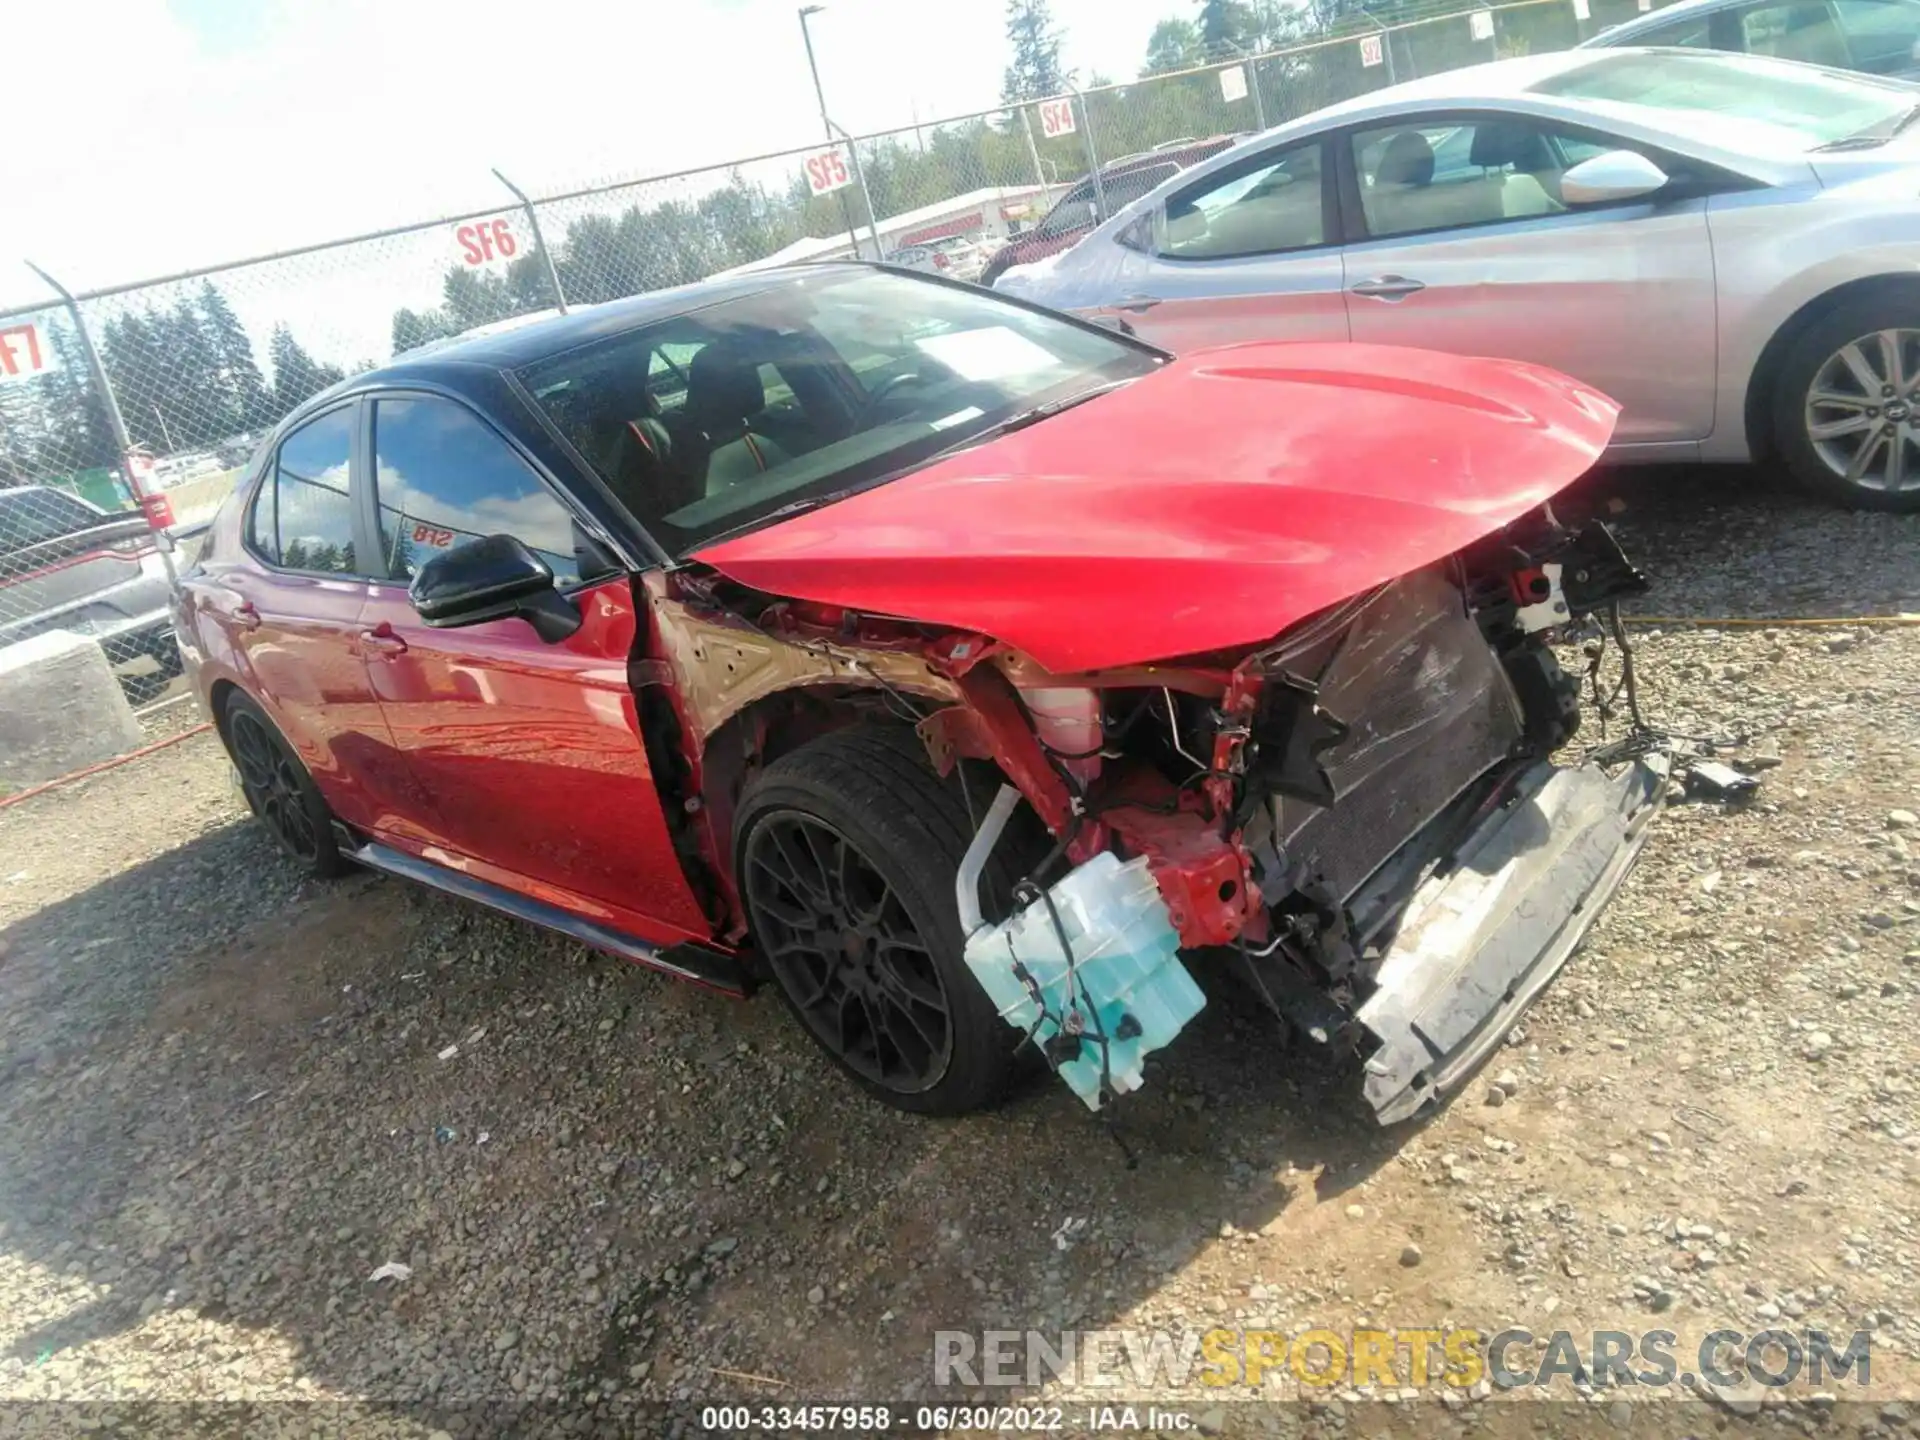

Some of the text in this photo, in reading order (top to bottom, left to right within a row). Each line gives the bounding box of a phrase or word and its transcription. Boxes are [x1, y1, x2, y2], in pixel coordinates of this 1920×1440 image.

[1042, 102, 1073, 134] SF4
[807, 150, 847, 190] SF5
[457, 218, 516, 265] SF6
[0, 323, 42, 376] F7
